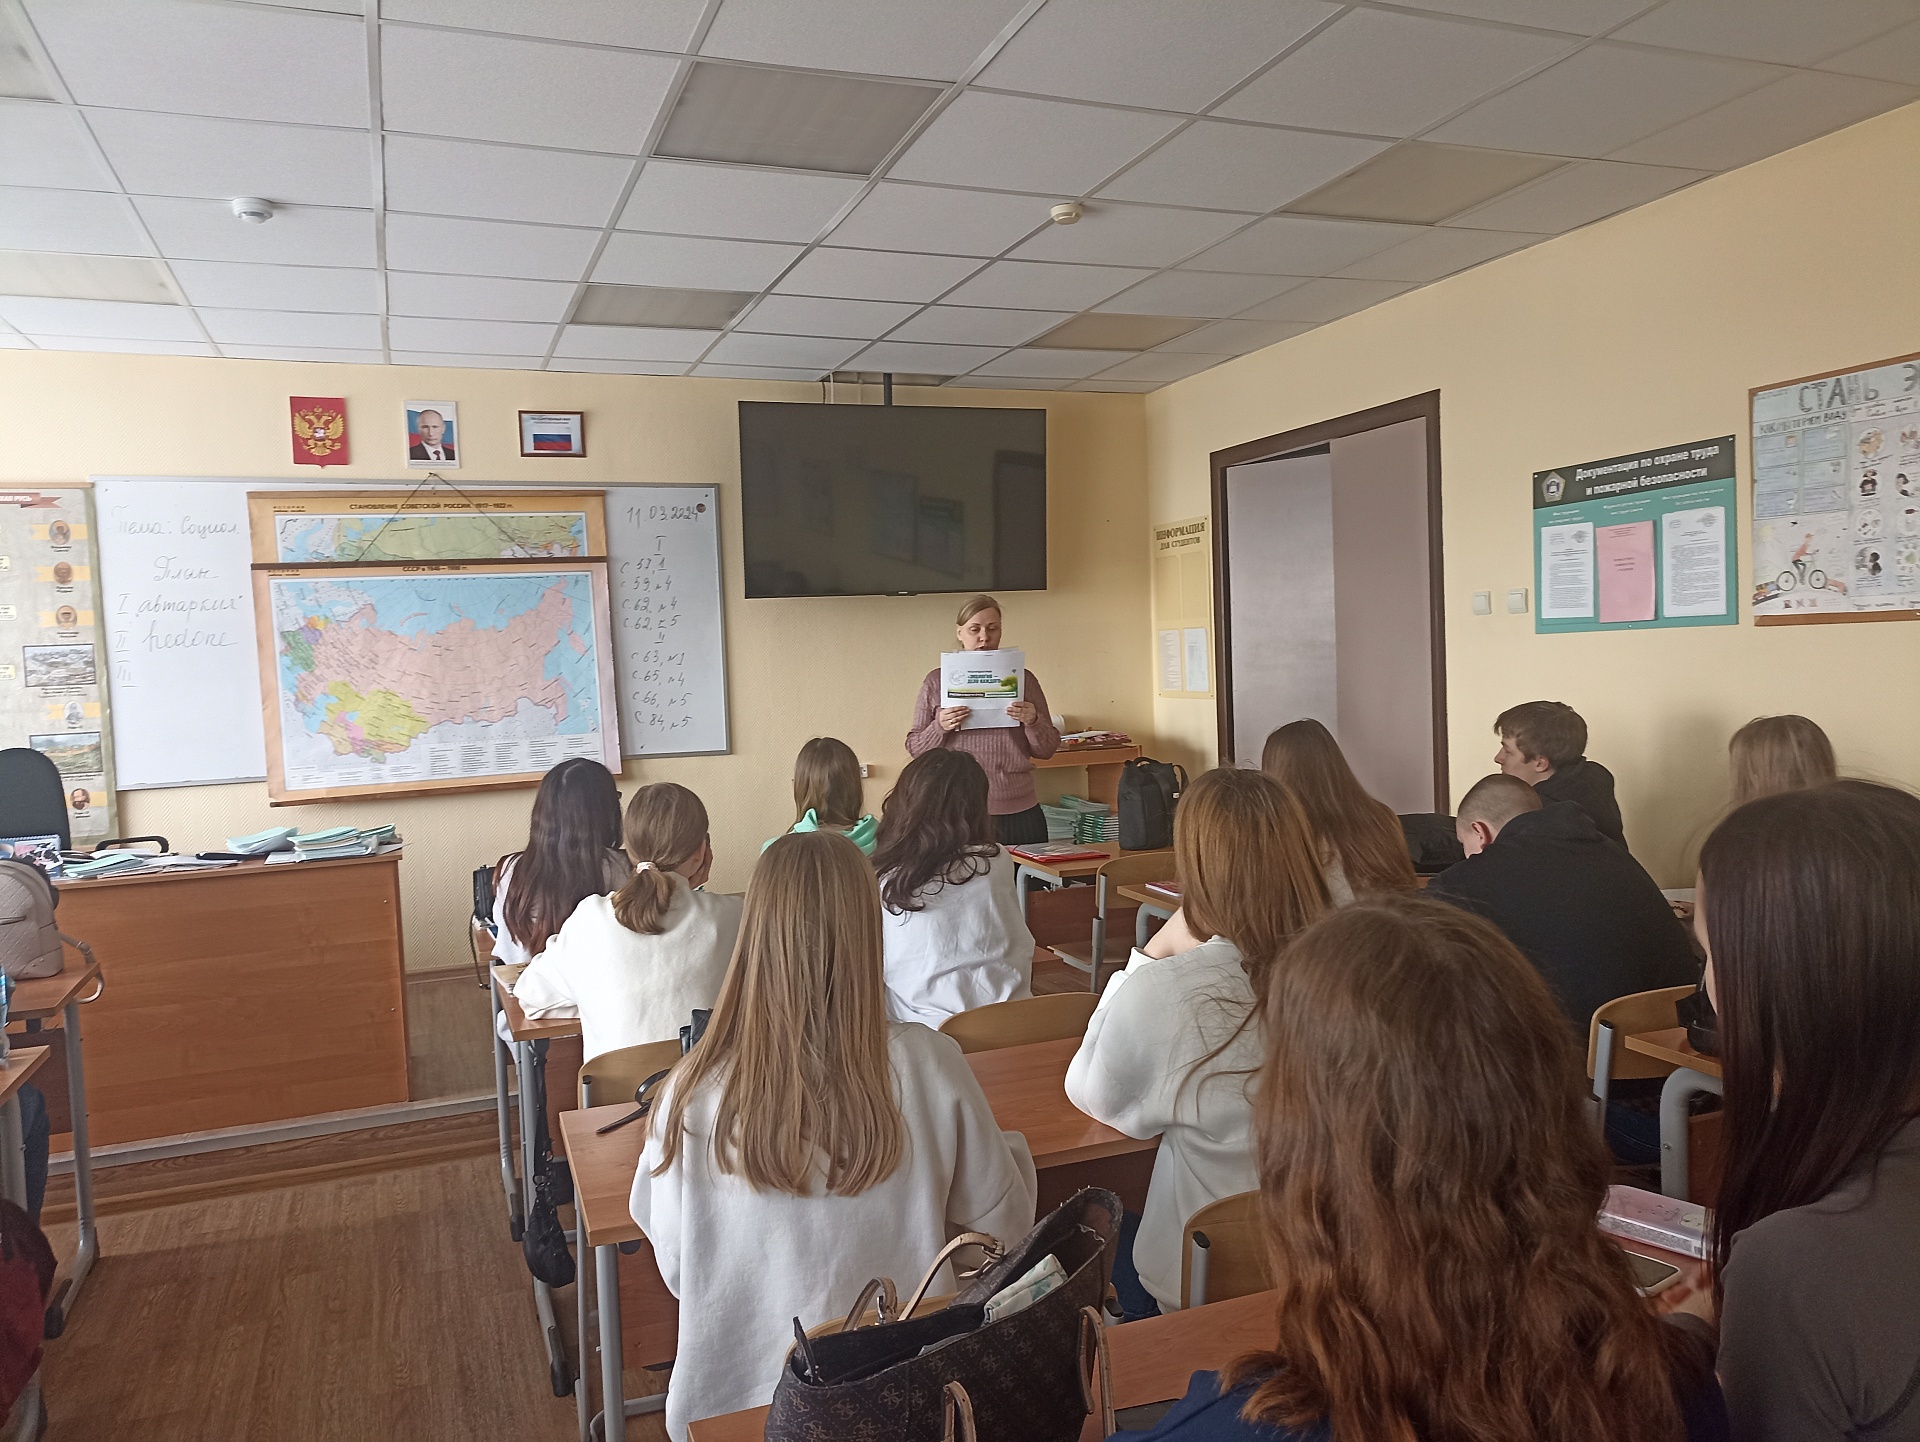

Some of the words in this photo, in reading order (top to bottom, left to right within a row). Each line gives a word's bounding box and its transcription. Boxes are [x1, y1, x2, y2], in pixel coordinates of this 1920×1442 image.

[1799, 374, 1879, 413] СТАНЬ
[1902, 363, 1920, 393] Э
[1576, 460, 1640, 482] Документация
[1640, 457, 1653, 468] по
[1654, 450, 1689, 467] охране
[1691, 445, 1720, 461] труда
[1585, 486, 1593, 496] и
[1593, 477, 1639, 494] пожарной
[1639, 467, 1708, 488] безопасности
[1156, 521, 1206, 541] ИНФОРМАЦИЯ
[1171, 536, 1201, 549] СТУДЕНТОВ
